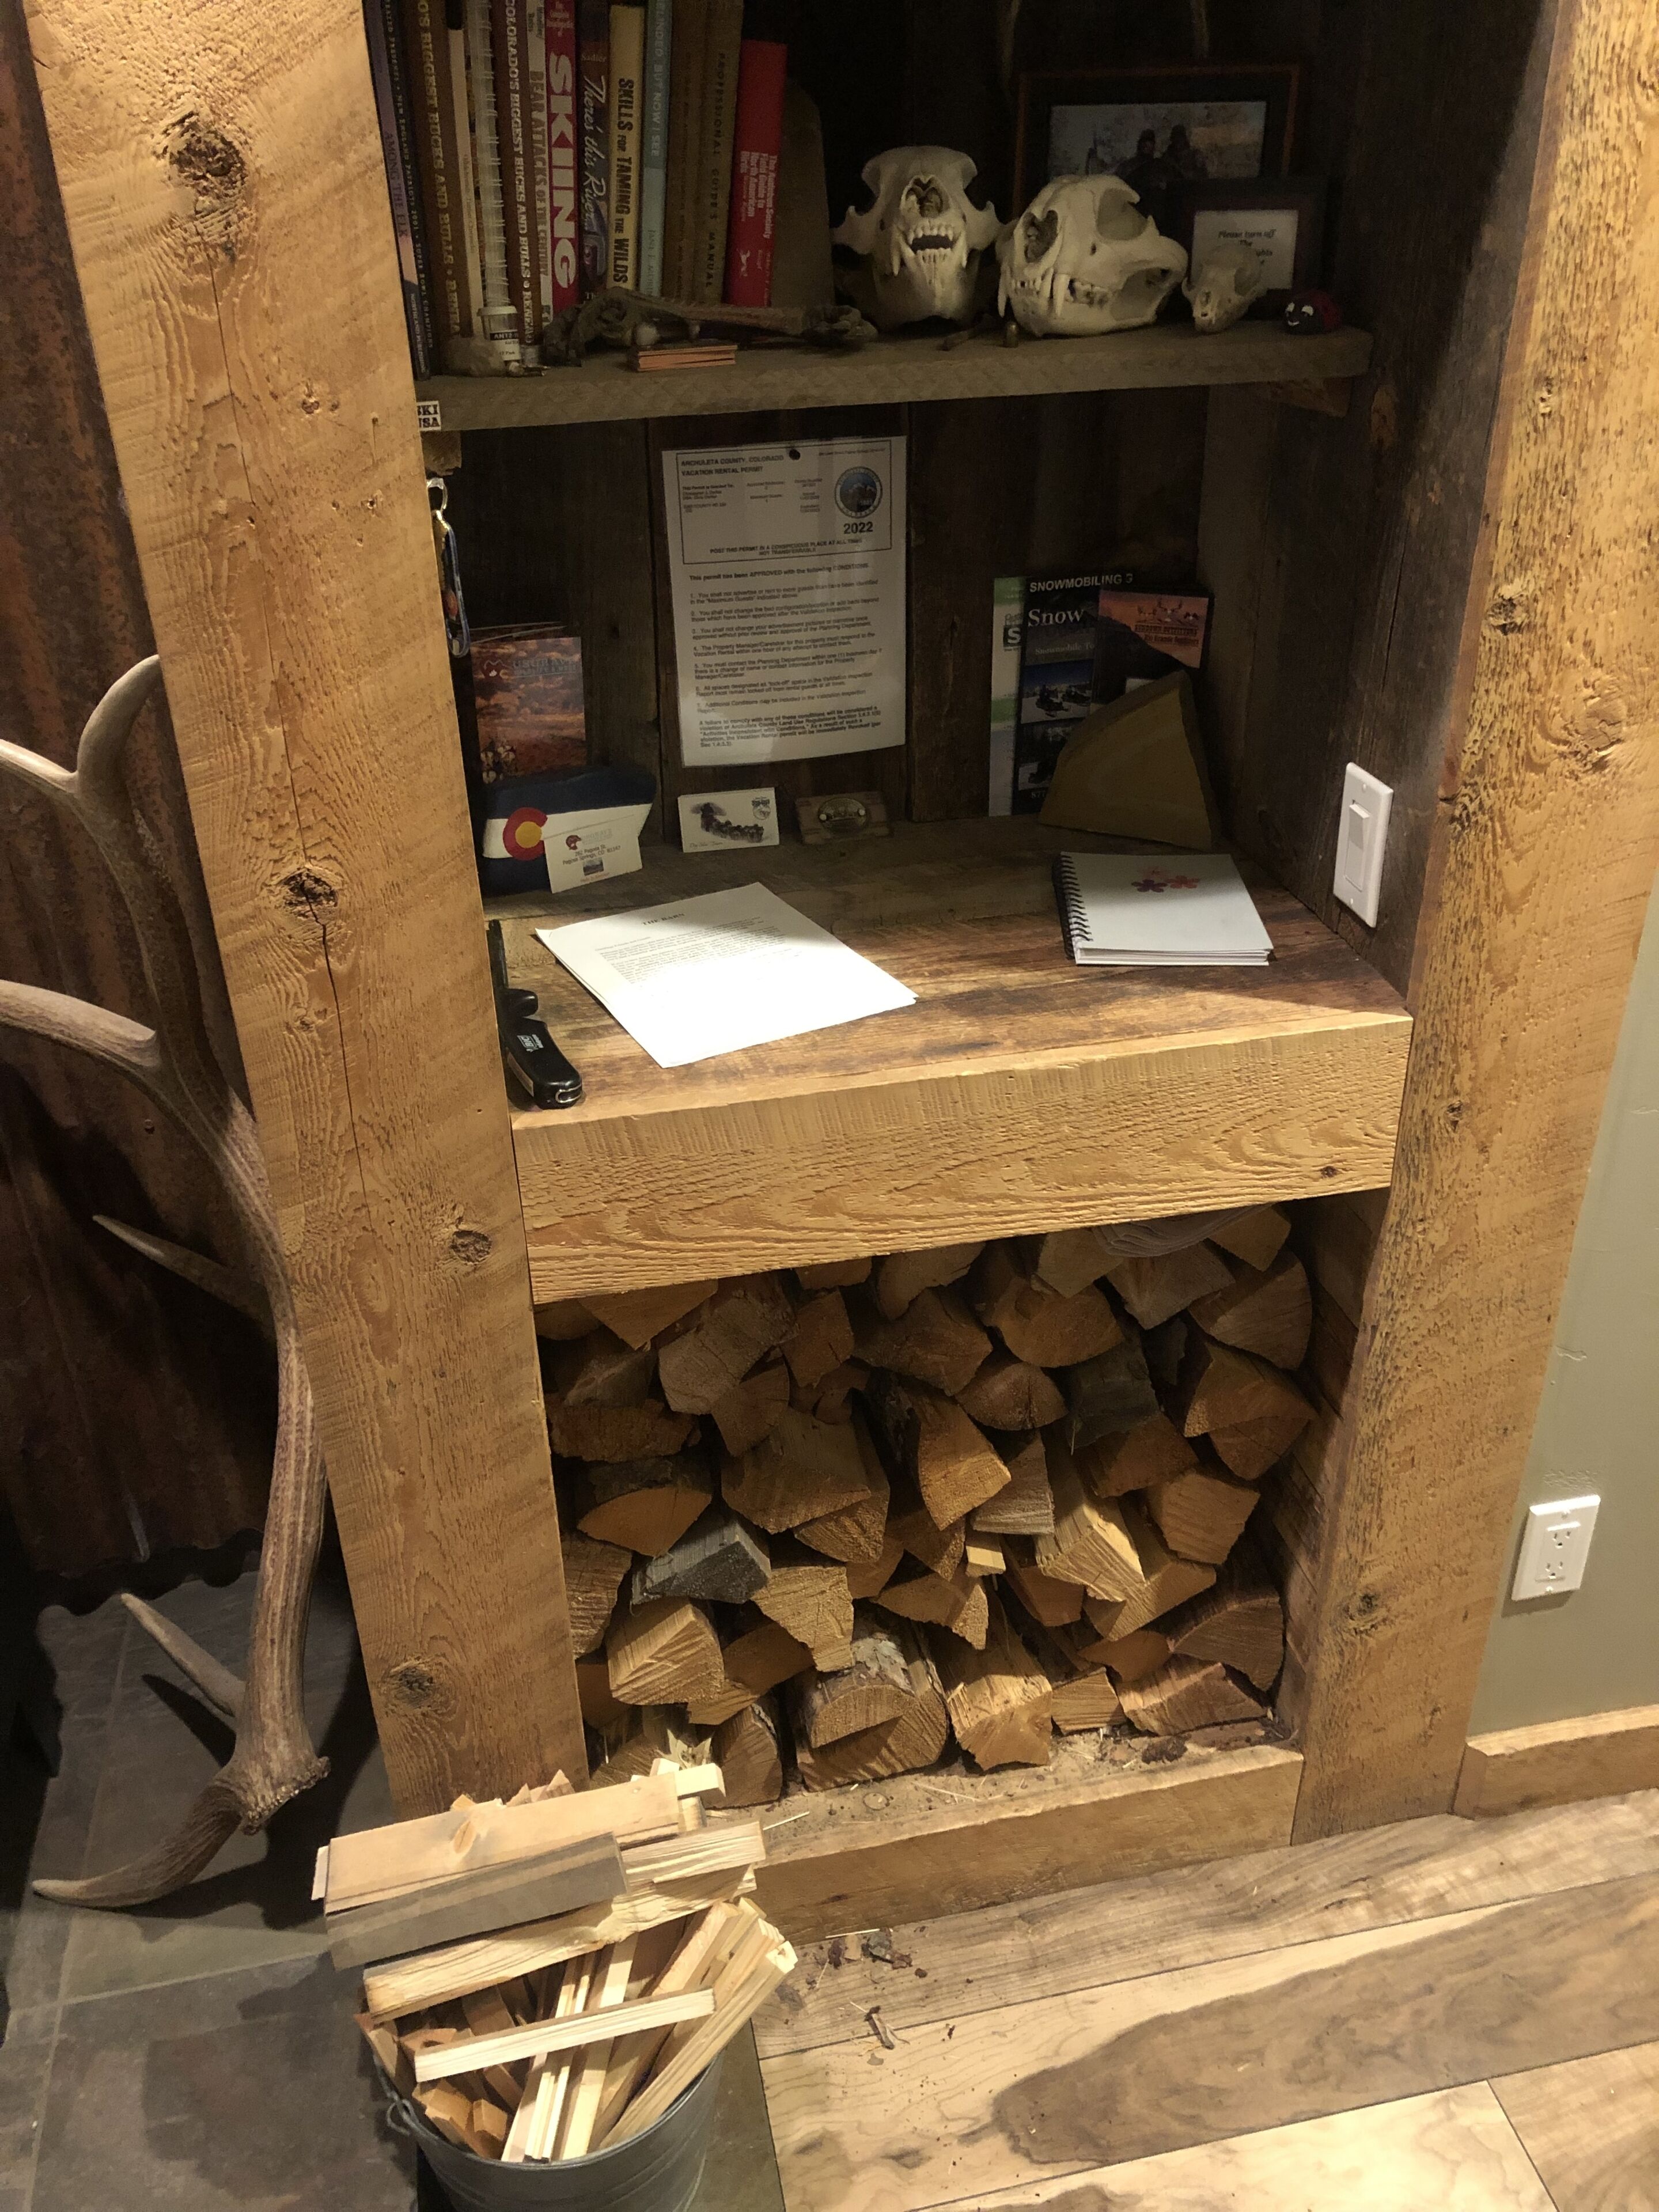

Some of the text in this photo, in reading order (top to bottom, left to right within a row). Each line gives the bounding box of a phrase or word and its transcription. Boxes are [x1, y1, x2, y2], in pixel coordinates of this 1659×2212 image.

[419, 32, 439, 108] BIGGEST
[653, 65, 665, 89] BUT
[582, 75, 607, 131] There's
[652, 92, 663, 123] NOW
[509, 93, 523, 154] BIGGEST
[427, 112, 445, 169] BUCKS
[582, 135, 605, 168] this
[650, 135, 660, 157] SEE
[514, 157, 526, 202] BUCKS
[529, 70, 548, 276] BEAR ATTACKS OF THE CENTURY
[548, 53, 578, 289] SKIING
[767, 154, 778, 172] The
[384, 132, 409, 238] AMONG THE ELK
[434, 173, 449, 209] AND
[612, 78, 635, 283] SKILLS FOR TAMING THE WILDS
[747, 151, 760, 218] North American
[756, 175, 768, 199] Guide
[516, 204, 528, 234] AND
[762, 209, 774, 240] Society
[438, 212, 454, 264] BULLS
[518, 236, 531, 278] BULLS
[704, 232, 717, 289] MANUAL
[681, 468, 713, 476] VACATION
[843, 521, 873, 535] 2022
[703, 574, 721, 582] permit
[749, 569, 782, 578] APPROVED
[1029, 574, 1123, 593] SNOWMOBILING
[1028, 608, 1084, 627] Snow
[642, 912, 685, 926] THE BARN
[520, 1036, 535, 1048] BIC
